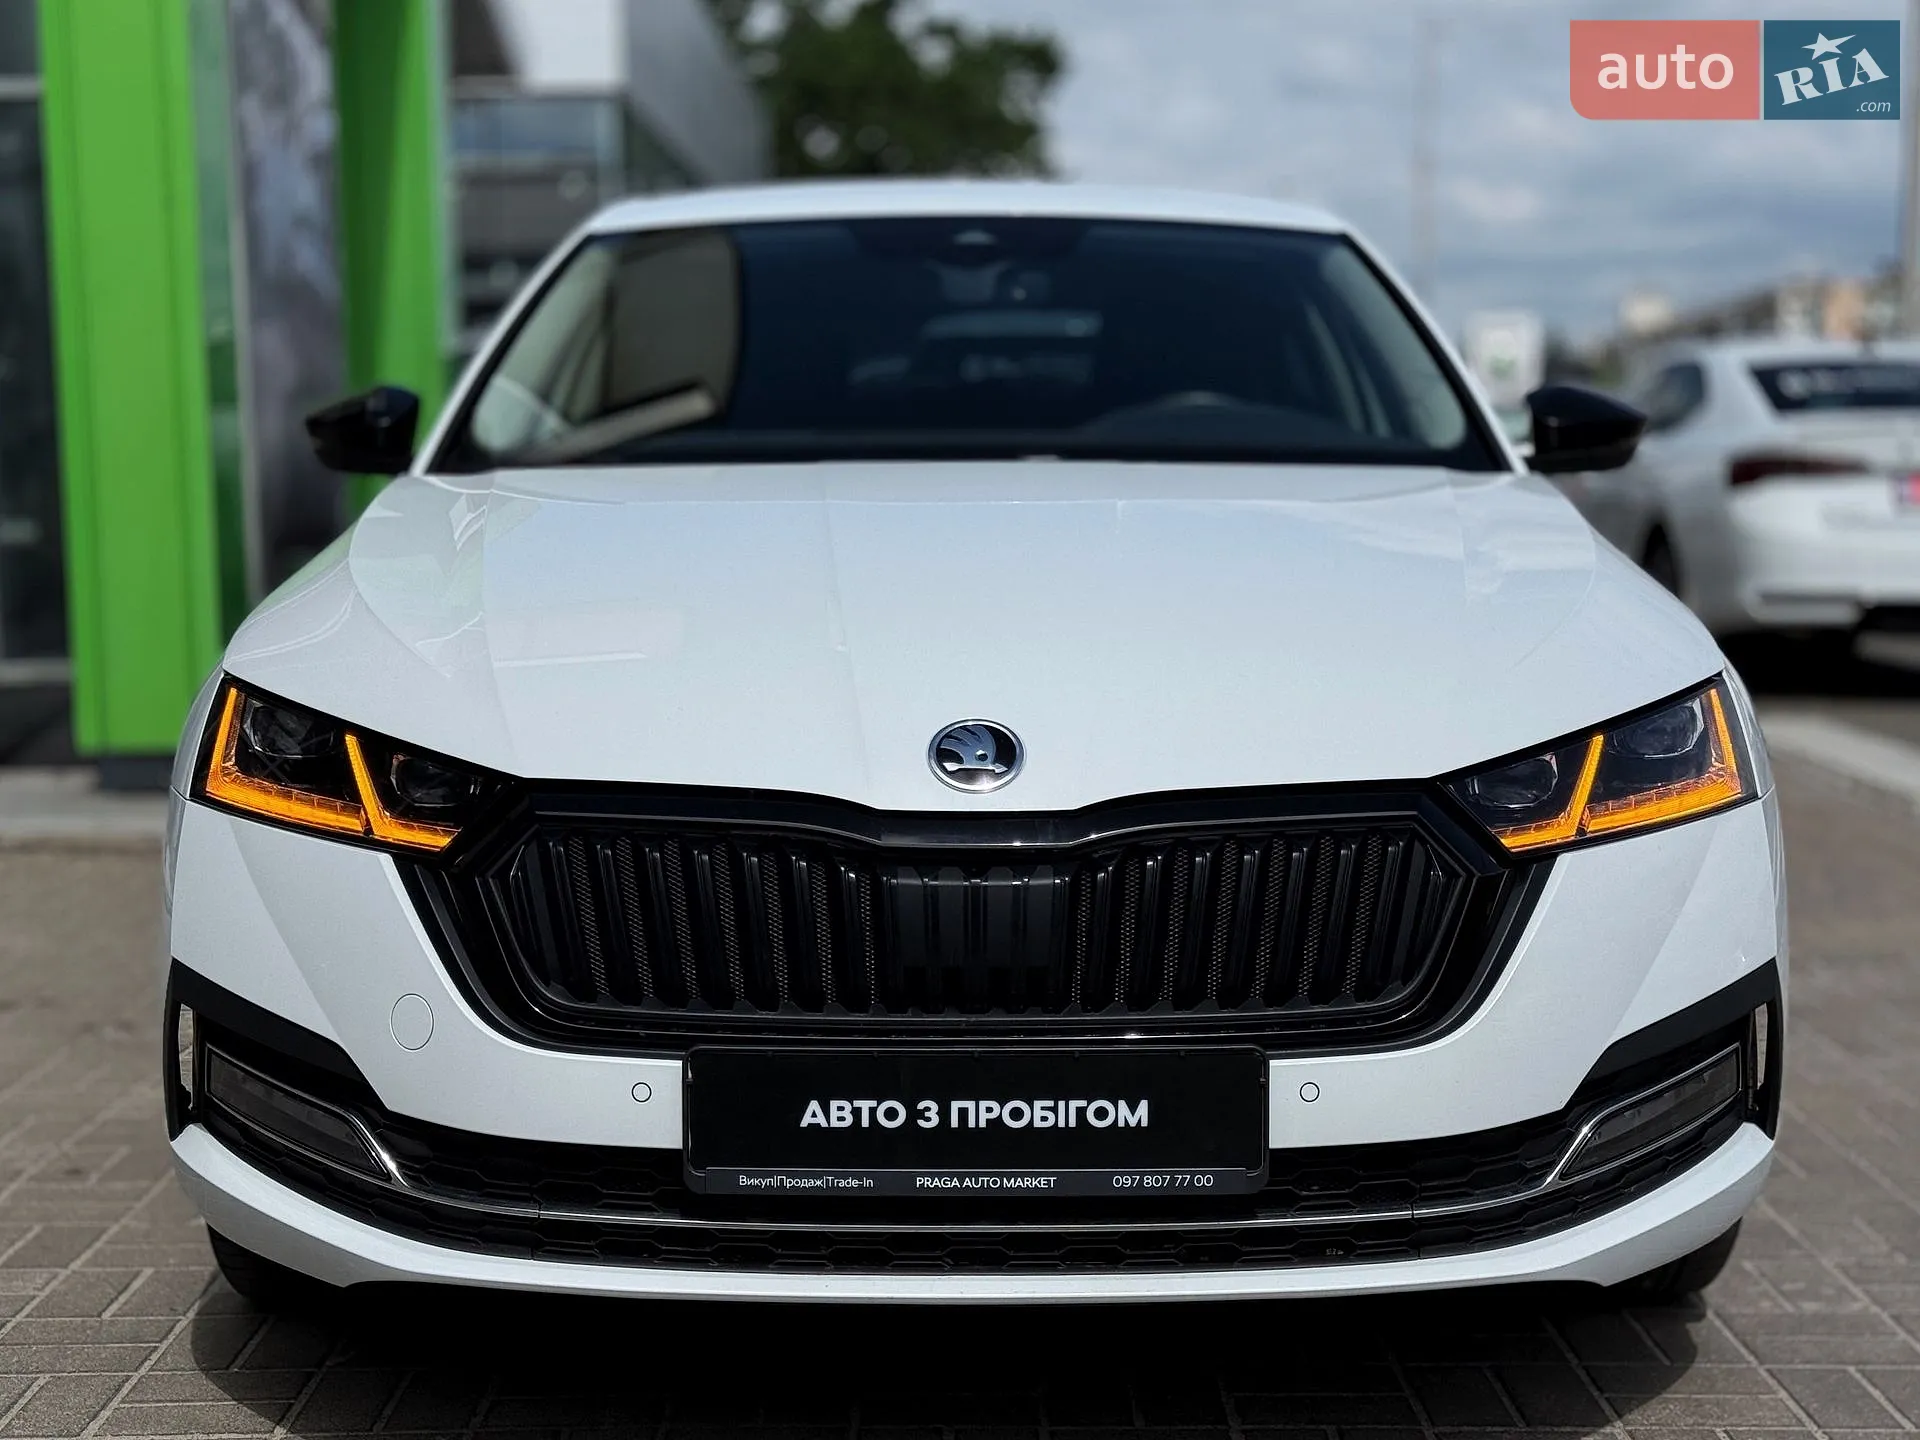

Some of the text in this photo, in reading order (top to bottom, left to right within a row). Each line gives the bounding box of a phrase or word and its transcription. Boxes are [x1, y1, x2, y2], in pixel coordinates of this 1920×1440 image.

[799, 1099, 907, 1129] АВТО
[950, 1099, 1149, 1129] ПРОБІГОМ
[916, 1176, 1057, 1188] PRAGA AUTO MARKET
[1112, 1174, 1214, 1188] 097 807 77 00
